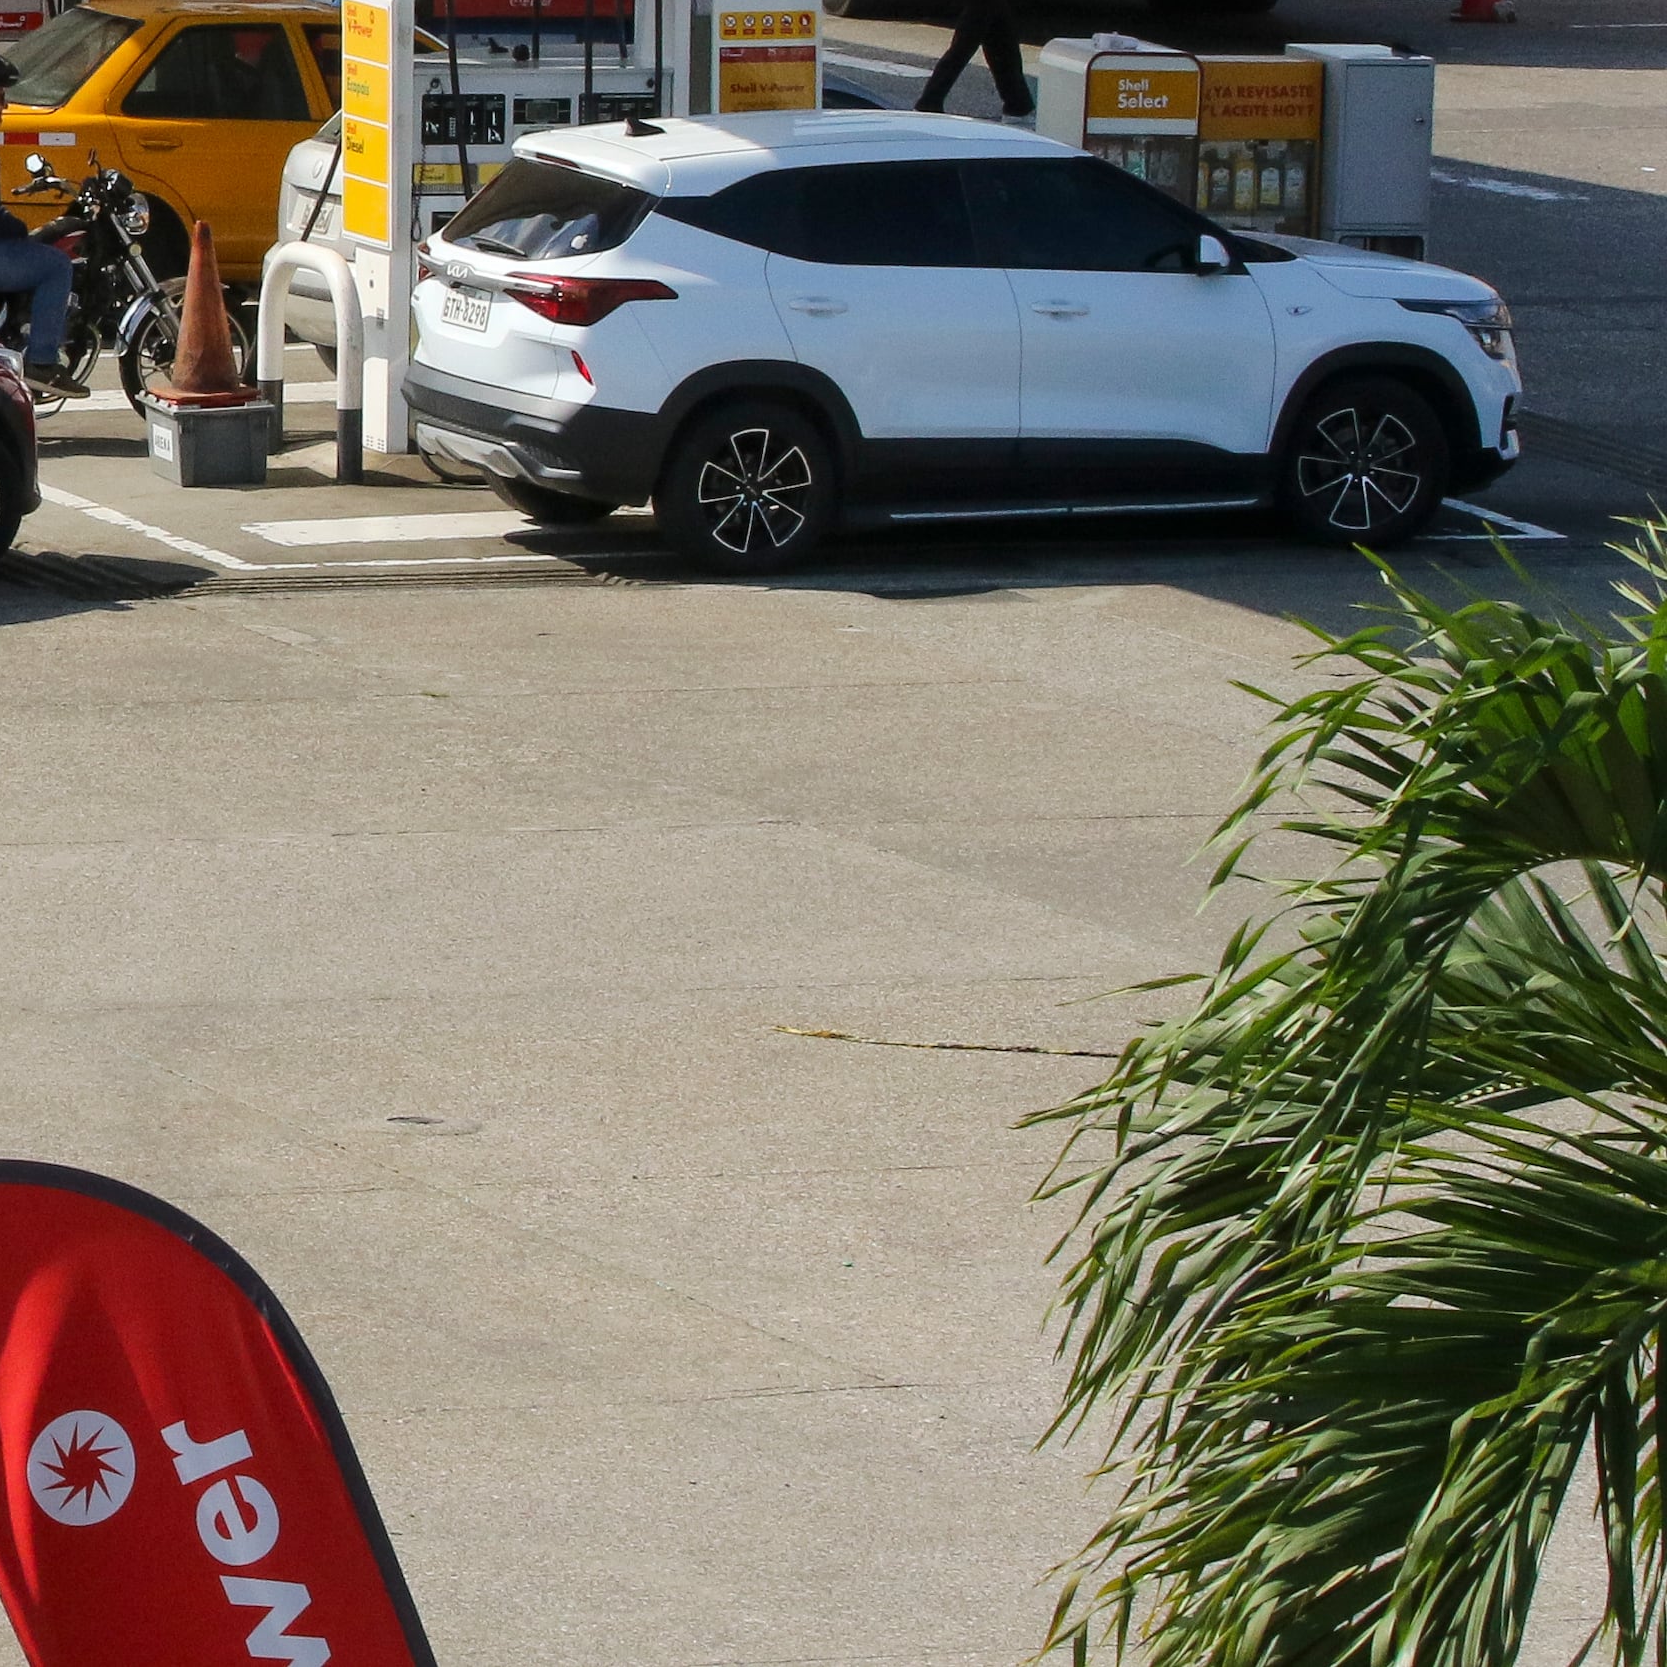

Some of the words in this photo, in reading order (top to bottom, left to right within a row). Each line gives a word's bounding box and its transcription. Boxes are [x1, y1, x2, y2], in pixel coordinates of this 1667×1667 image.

[1118, 79, 1149, 92] Shell
[1237, 84, 1314, 99] REVISASTE
[1118, 94, 1169, 109] Select
